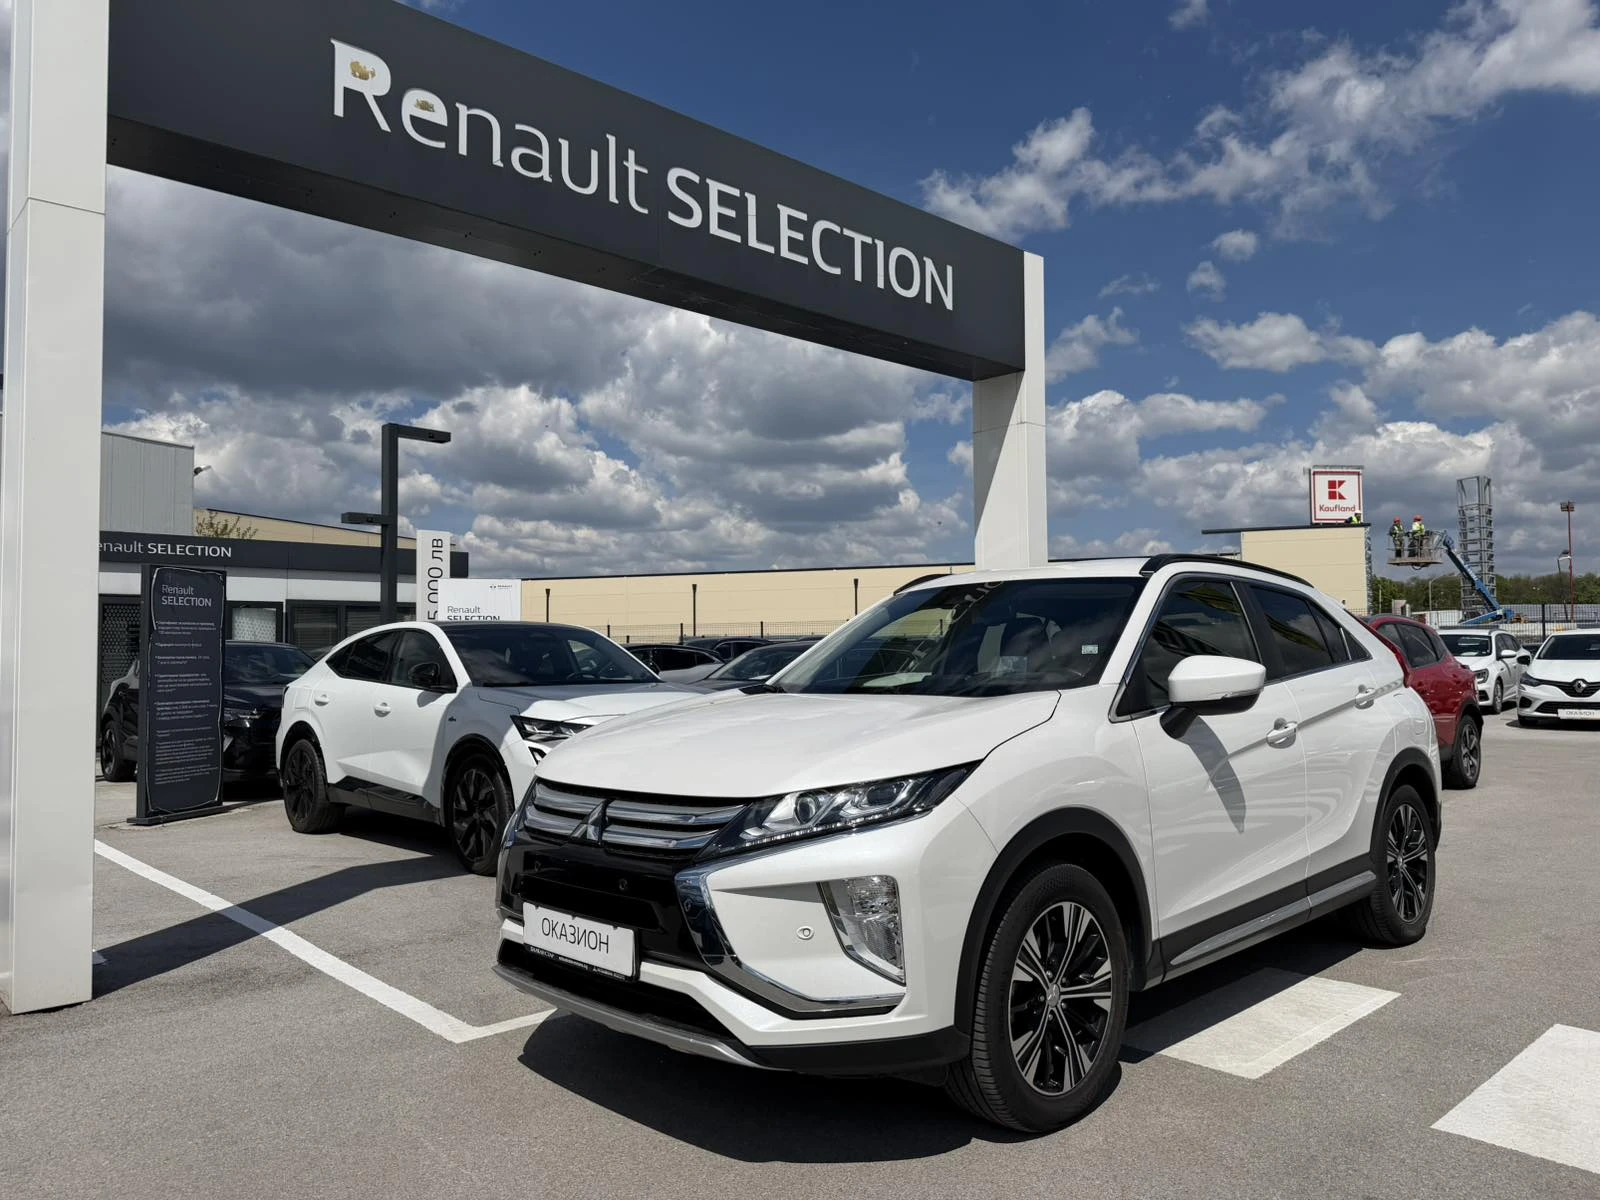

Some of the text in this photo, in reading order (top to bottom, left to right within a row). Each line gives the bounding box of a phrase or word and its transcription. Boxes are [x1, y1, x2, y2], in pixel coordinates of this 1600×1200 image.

[330, 38, 954, 311] Renault SELECTION
[1319, 504, 1356, 512] Kaufland
[147, 542, 232, 557] SELECTION
[162, 584, 194, 595] Renault
[161, 596, 212, 607] SELECTION
[447, 605, 481, 614] Renault
[541, 917, 609, 954] ОКАЗИОН
